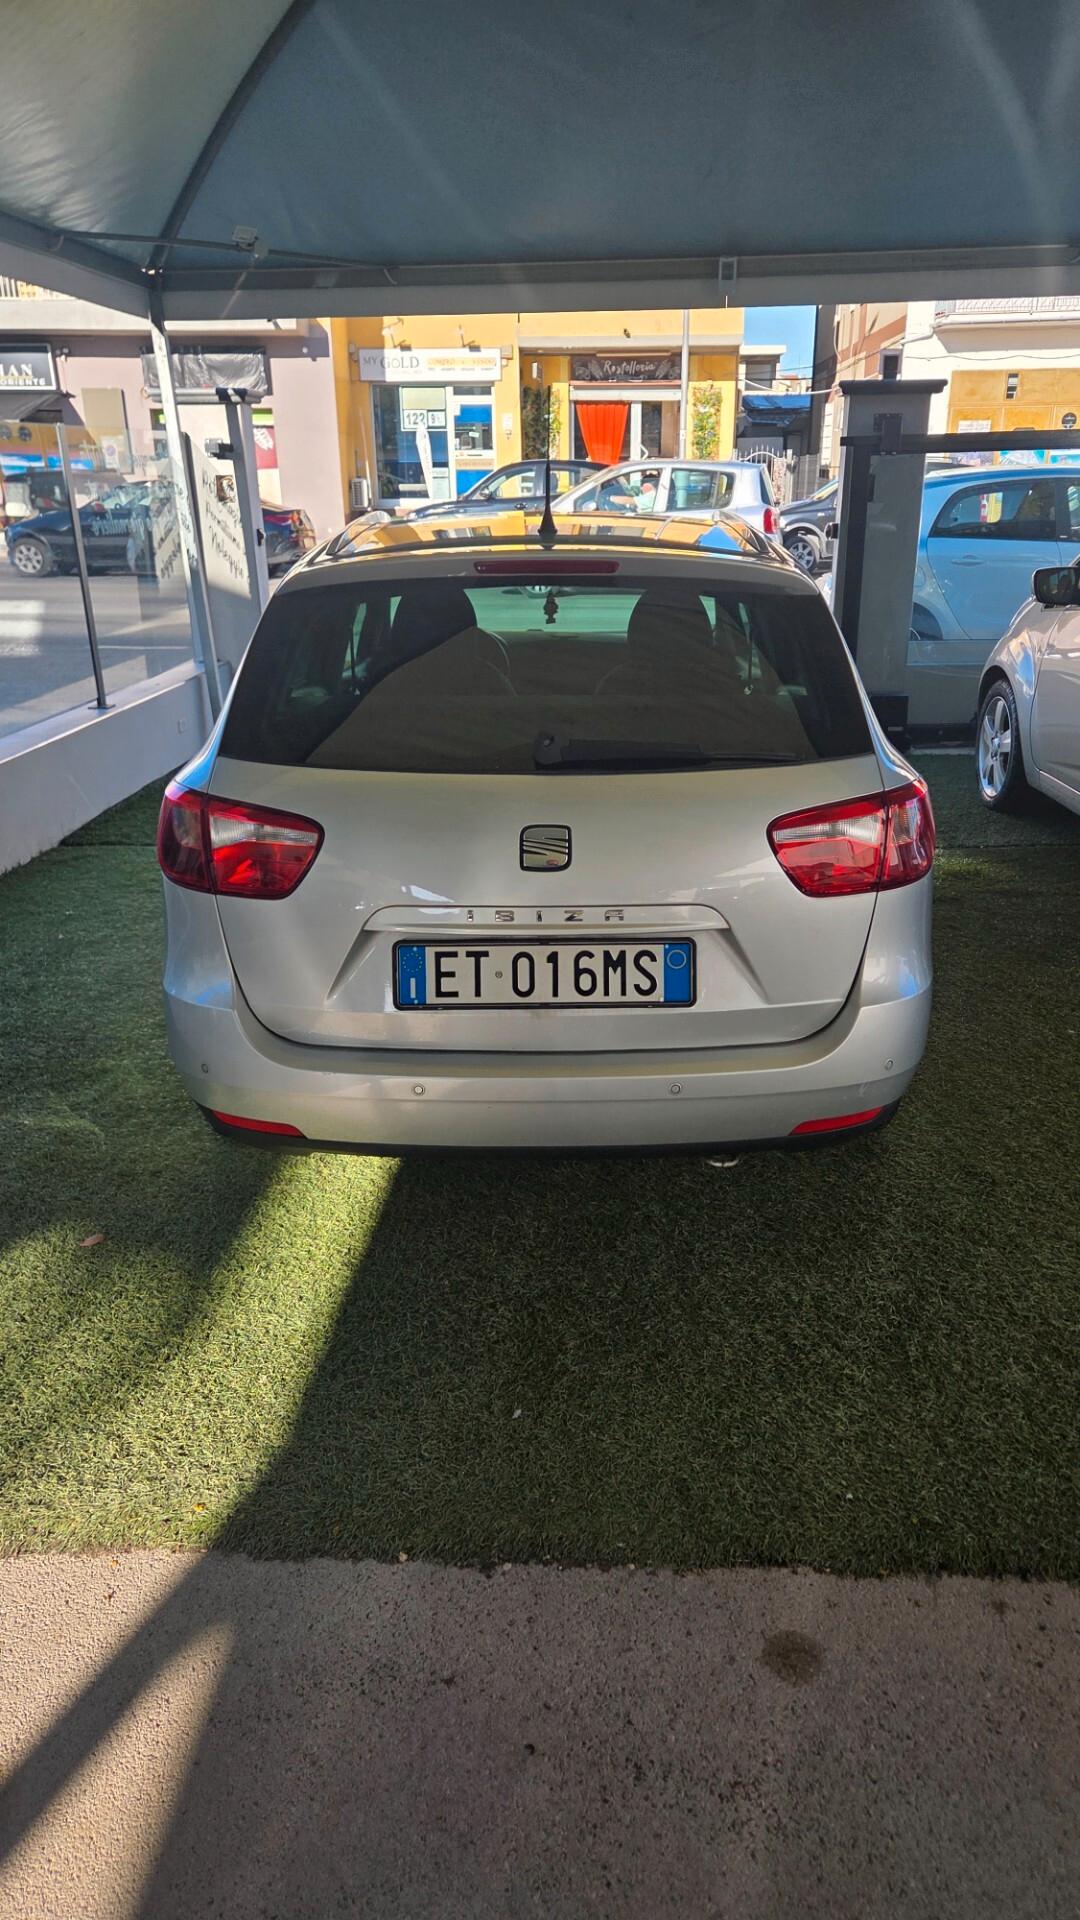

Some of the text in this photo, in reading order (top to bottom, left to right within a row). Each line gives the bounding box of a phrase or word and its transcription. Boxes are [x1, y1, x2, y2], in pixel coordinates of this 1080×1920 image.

[363, 355, 420, 369] MY GOLD
[466, 909, 625, 922] IBIZA
[434, 949, 659, 998] ET 016MS
